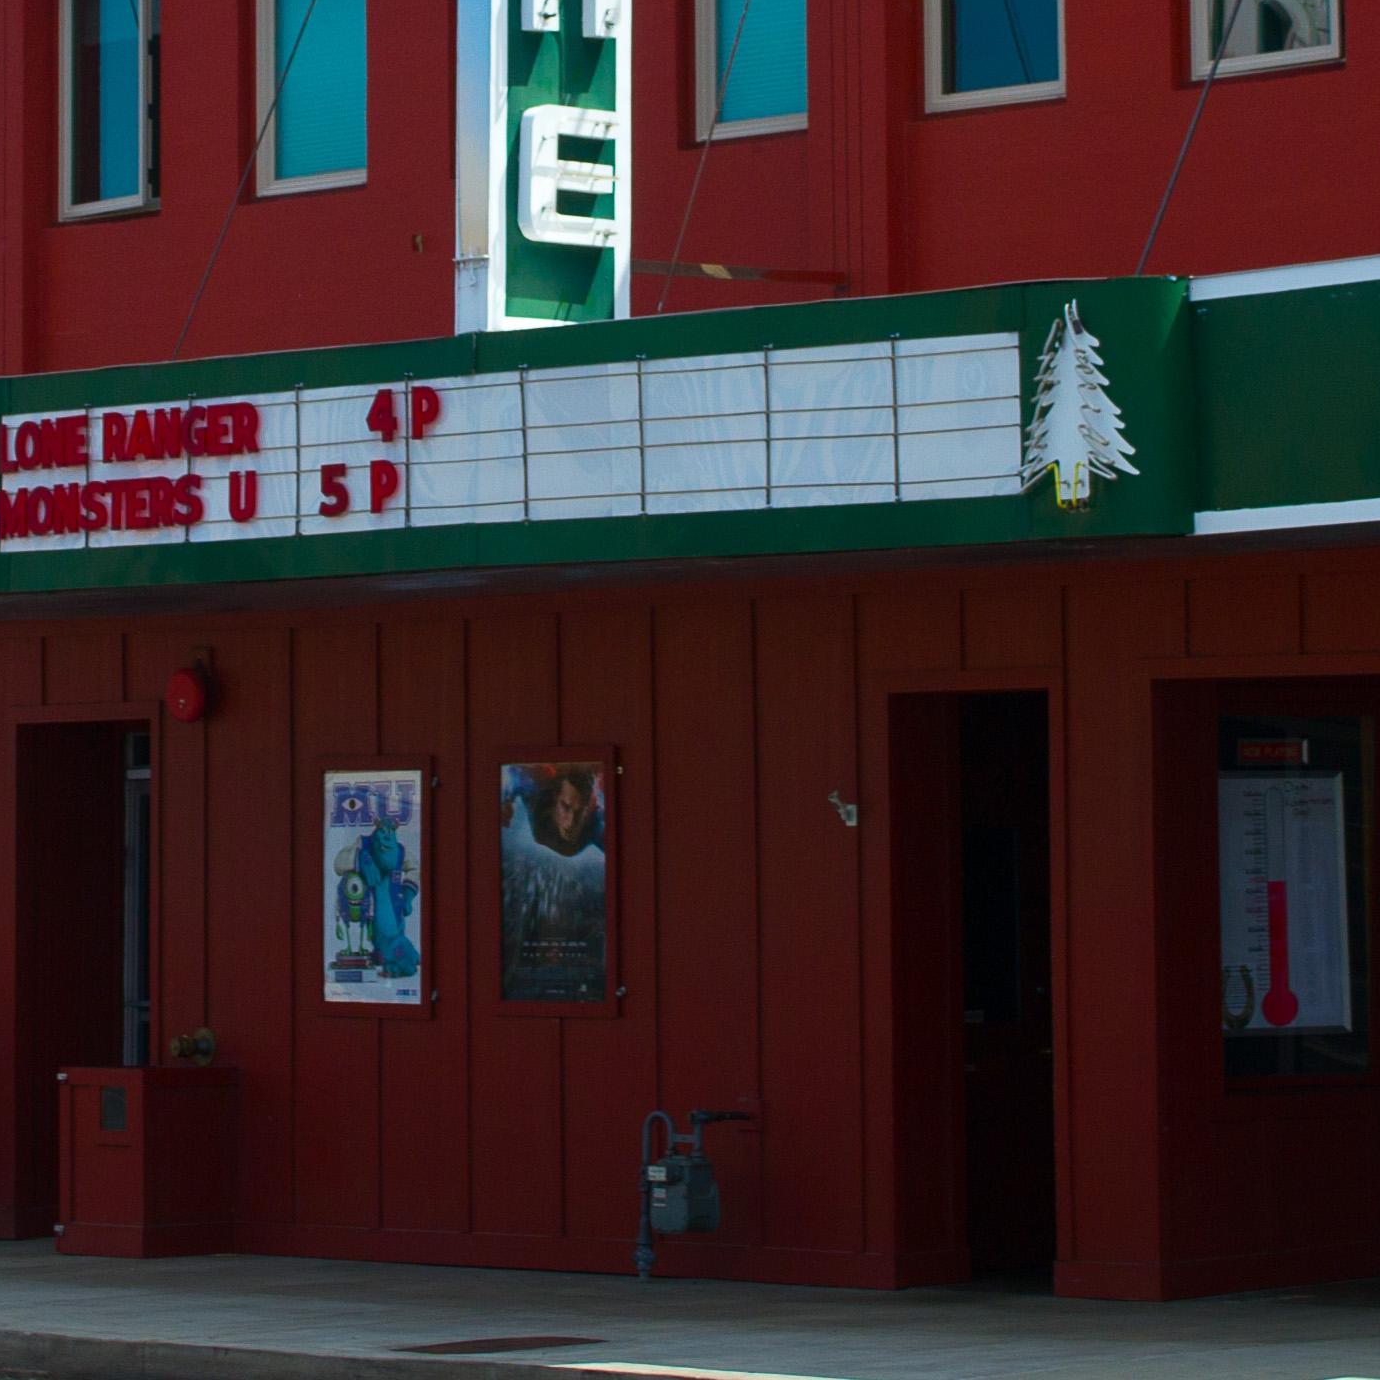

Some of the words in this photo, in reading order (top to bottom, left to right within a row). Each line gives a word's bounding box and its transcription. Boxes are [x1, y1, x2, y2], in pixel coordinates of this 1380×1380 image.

[101, 400, 262, 464] RANGER
[365, 388, 399, 443] 4
[411, 385, 440, 440] P
[228, 470, 258, 522] U
[319, 462, 350, 518] 5
[370, 459, 399, 514] P
[330, 781, 414, 827] MU
